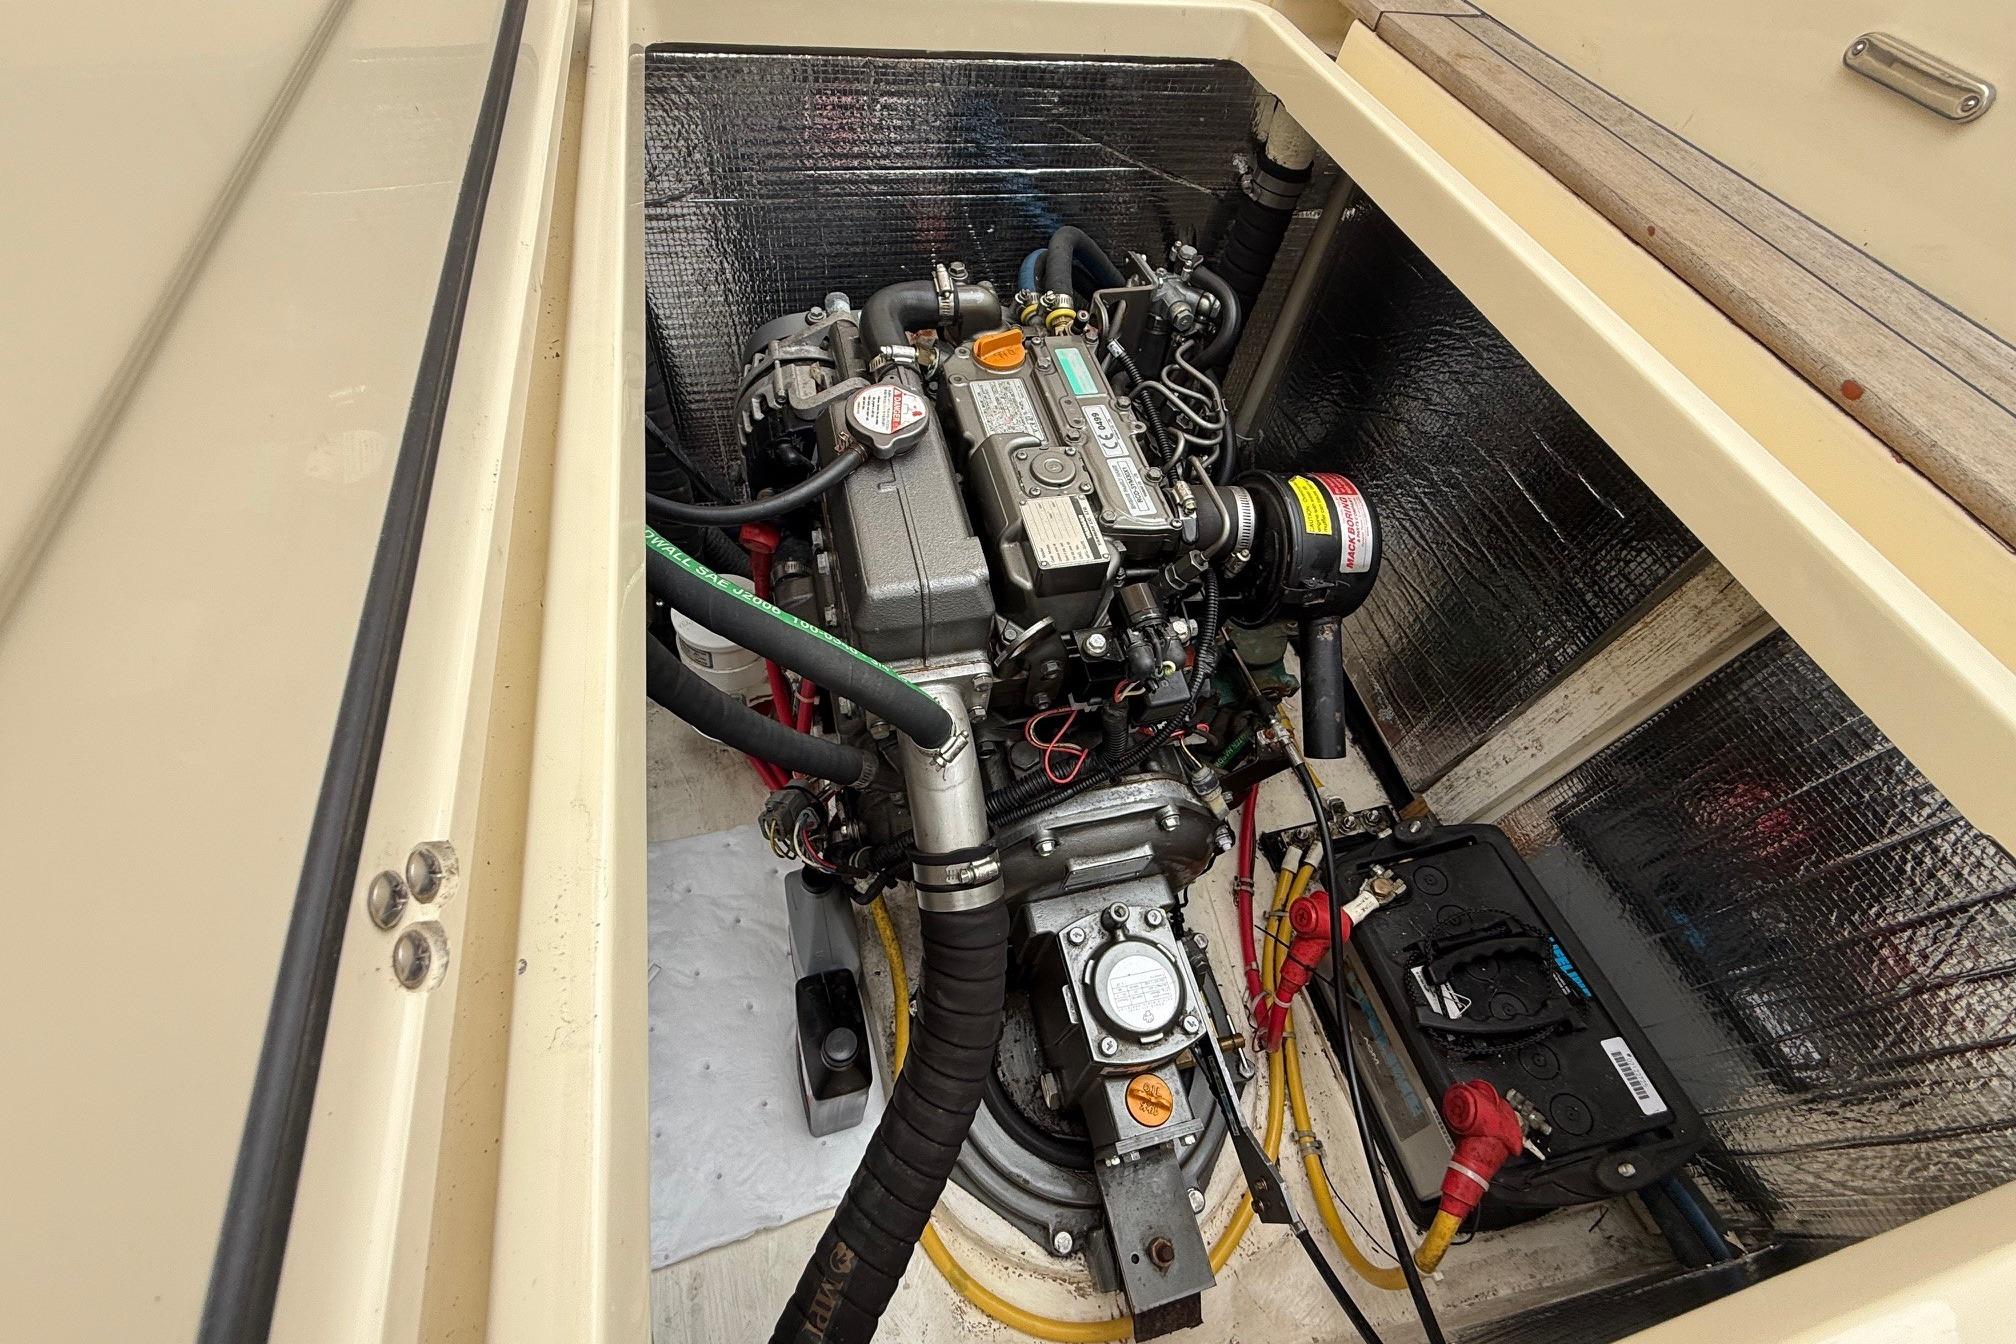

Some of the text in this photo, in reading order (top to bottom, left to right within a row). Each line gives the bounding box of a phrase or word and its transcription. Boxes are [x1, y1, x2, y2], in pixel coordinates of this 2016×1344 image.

[893, 397, 903, 421] DANGER
[1090, 412, 1106, 431] 0499
[1340, 496, 1355, 535] BORING
[1346, 536, 1356, 569] MACK
[695, 565, 730, 588] SAE
[732, 587, 782, 615] J2006
[1142, 1081, 1162, 1098] OIL
[801, 1277, 844, 1339] MPI
